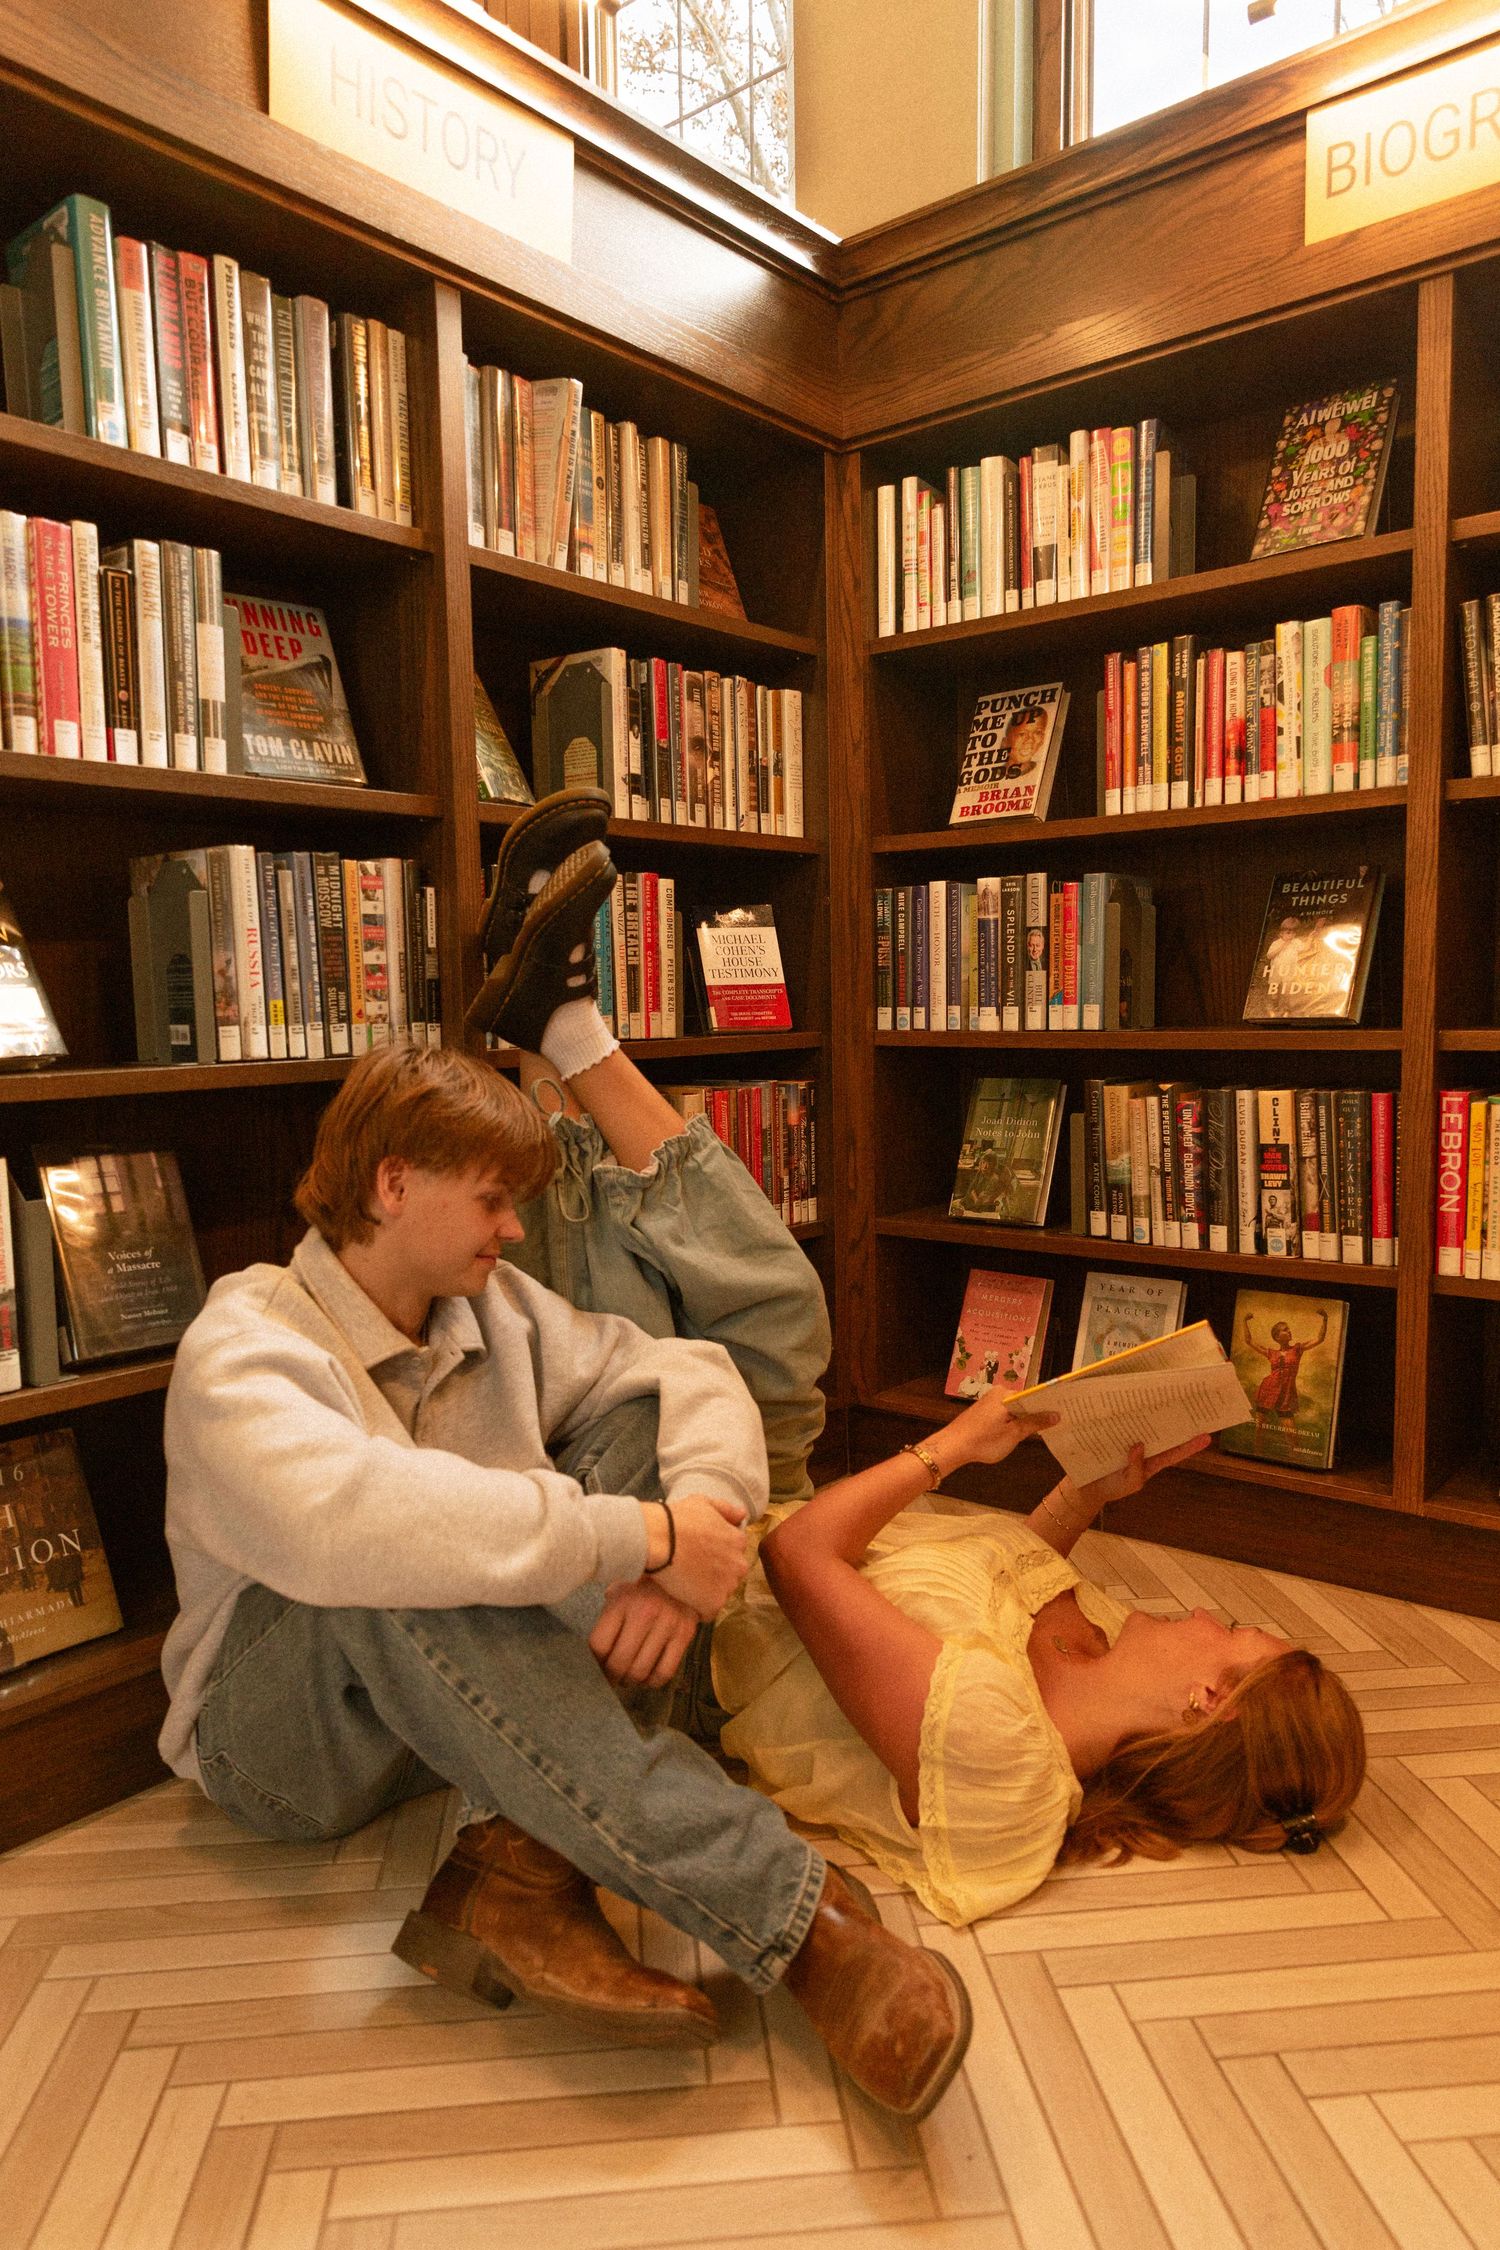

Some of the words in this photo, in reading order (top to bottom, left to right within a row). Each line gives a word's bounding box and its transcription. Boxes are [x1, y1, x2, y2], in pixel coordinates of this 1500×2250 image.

[328, 44, 527, 199] HISTORY
[1326, 86, 1500, 200] BIOGR
[90, 214, 108, 281] ADVANCE
[225, 263, 235, 349] PRISONERS
[95, 288, 114, 368] BRITANNIA
[569, 430, 578, 455] WORD
[1303, 440, 1350, 466] 1000
[568, 457, 575, 467] IS
[1281, 490, 1350, 516] SORROWS
[641, 491, 649, 544] WASHINGTON
[44, 536, 53, 550] IN
[58, 541, 67, 566] THE
[45, 556, 54, 579] THE
[141, 551, 160, 620] ENDGAME
[182, 575, 190, 591] THE
[45, 584, 58, 647] TOWER
[58, 571, 71, 649] PRINCES
[182, 594, 192, 641] FREQUENT
[223, 597, 322, 638] NNING
[241, 630, 302, 661] DEEP
[185, 643, 193, 687] TROUBLES
[1141, 654, 1149, 670] THE
[1464, 625, 1480, 695] STOWAWAY
[1141, 672, 1149, 707] DOCTORS
[1229, 668, 1237, 689] LONG
[186, 704, 194, 723] OUR
[975, 687, 1059, 717] PUNCH
[1343, 678, 1352, 728] BROWNS
[971, 715, 1006, 734] ME
[1012, 709, 1043, 726] UP
[1140, 709, 1149, 757] BLACKWELL
[243, 733, 285, 758] TOM
[289, 738, 355, 765] CLAVIN
[968, 732, 998, 751] TO
[963, 747, 1012, 769] THE
[1175, 746, 1183, 776] GOLD
[959, 763, 1022, 787] GODS
[978, 784, 1037, 802] BRIAN
[959, 798, 1032, 818] BROOME
[264, 863, 274, 885] The
[317, 866, 324, 874] IN
[328, 865, 343, 929] MIDNIGHT
[626, 883, 638, 906] THE
[1282, 878, 1365, 894] BEAUTIFUL
[265, 889, 277, 918] Fight
[318, 877, 332, 928] MOSCOW
[1031, 877, 1039, 924] CITIZEN
[1291, 893, 1348, 907] THINGS
[666, 888, 674, 950] COMPROMISED
[270, 936, 279, 959] Our
[626, 912, 639, 965] BREACH
[712, 934, 766, 944] MICHAEL
[715, 945, 766, 955] COHEN'S
[1007, 910, 1015, 964] SPLENDID
[1064, 933, 1074, 961] DADDY
[246, 928, 261, 989] RUSSIA
[722, 957, 762, 967] HOUSE
[878, 941, 890, 966] PUSH
[271, 963, 280, 993] Lives
[708, 968, 779, 978] TESTIMONY
[1064, 965, 1075, 999] DIARIES
[1007, 990, 1016, 1006] VIL
[1267, 982, 1331, 995] BIDEN
[327, 987, 338, 1023] SULLIVAN
[981, 1115, 1003, 1126] Joan
[1006, 1117, 1038, 1126] Didion
[1238, 1098, 1246, 1125] ELVIS
[1272, 1097, 1281, 1144] CLINT
[1300, 1102, 1311, 1127] Billie
[975, 1127, 1002, 1137] Notes
[1004, 1129, 1015, 1138] to
[1016, 1129, 1040, 1139] John
[1163, 1136, 1170, 1146] OF
[1182, 1109, 1193, 1147] UNTAMED
[1302, 1130, 1314, 1157] Eilish
[1440, 1097, 1463, 1212] LEBRON
[1184, 1153, 1194, 1190] GLENNON
[1346, 1130, 1356, 1228] ELIZABETH
[1185, 1193, 1195, 1217] DOYLE
[108, 1250, 141, 1260] Voices
[144, 1247, 154, 1259] of
[116, 1262, 160, 1272] Massacre
[1100, 1283, 1136, 1294] YEAR
[1146, 1288, 1164, 1296] OF
[967, 1308, 1032, 1323] ACQUISITIONS
[1096, 1304, 1160, 1319] PLAGUES
[1298, 1430, 1320, 1438] DREAM
